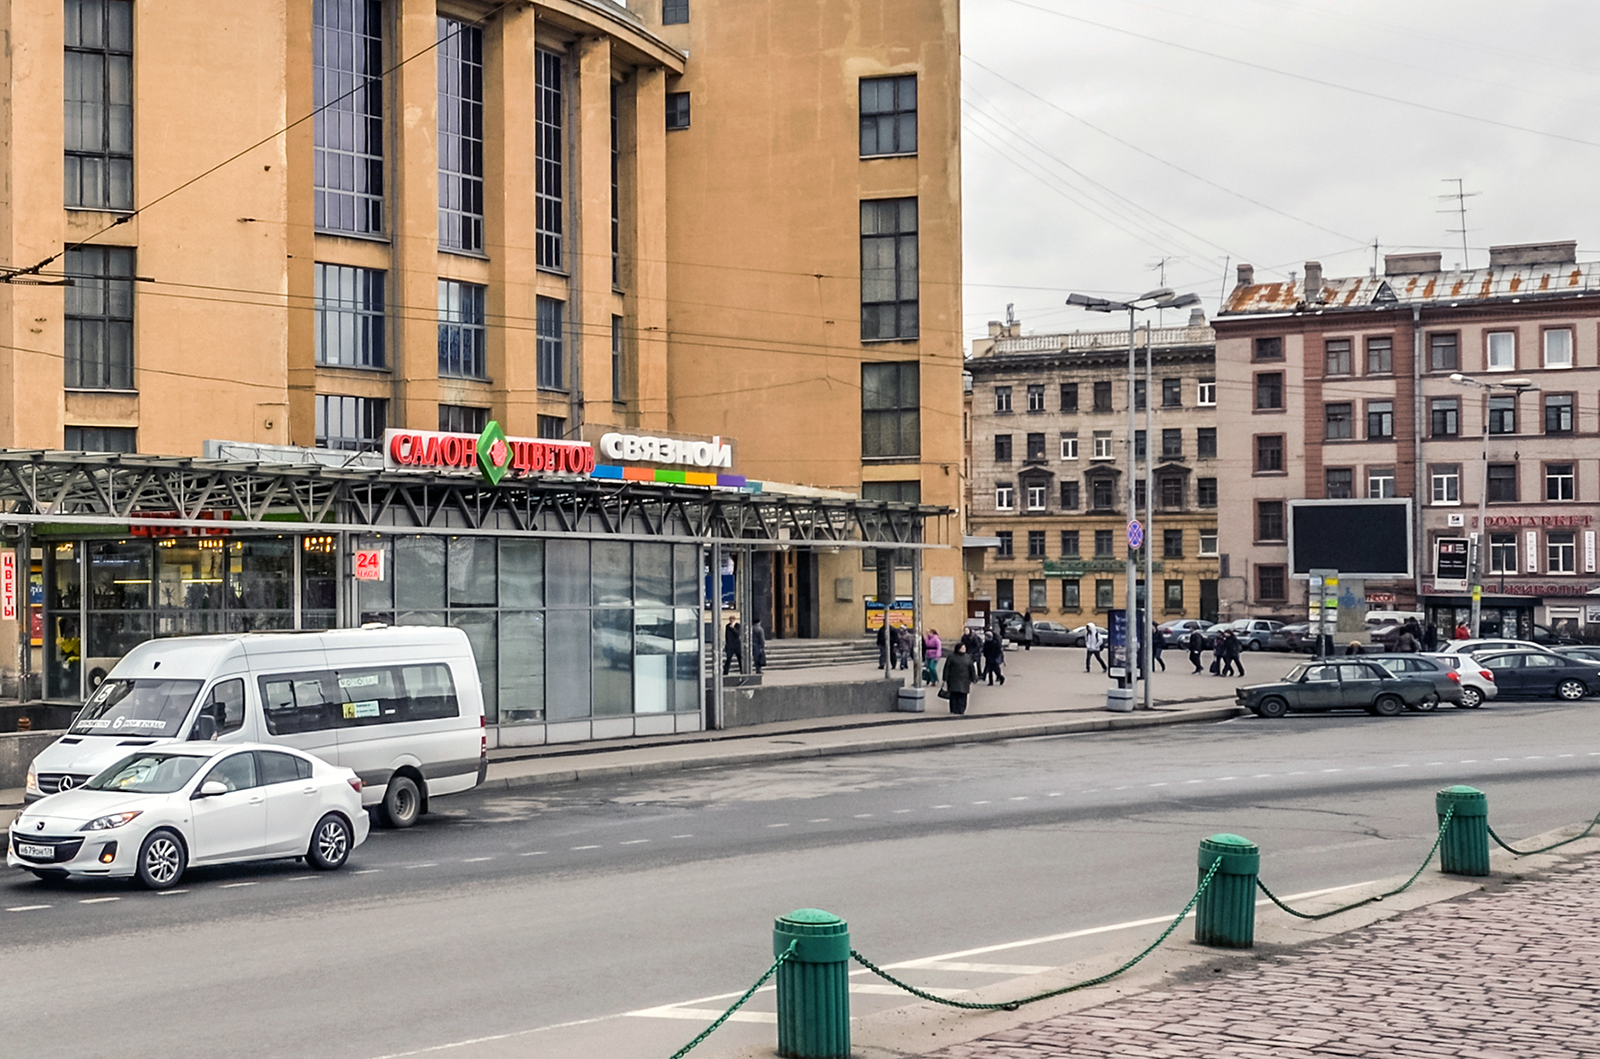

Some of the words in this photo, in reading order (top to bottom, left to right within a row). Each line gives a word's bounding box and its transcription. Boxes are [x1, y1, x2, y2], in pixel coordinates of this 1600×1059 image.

[390, 434, 477, 466] САЛОН
[513, 440, 595, 476] ЦВЕТОВ
[600, 432, 733, 469] СВЯЗНОЙ
[357, 553, 379, 568] 24
[4, 556, 14, 617] ЦВЕТЫ
[112, 716, 126, 730] 6
